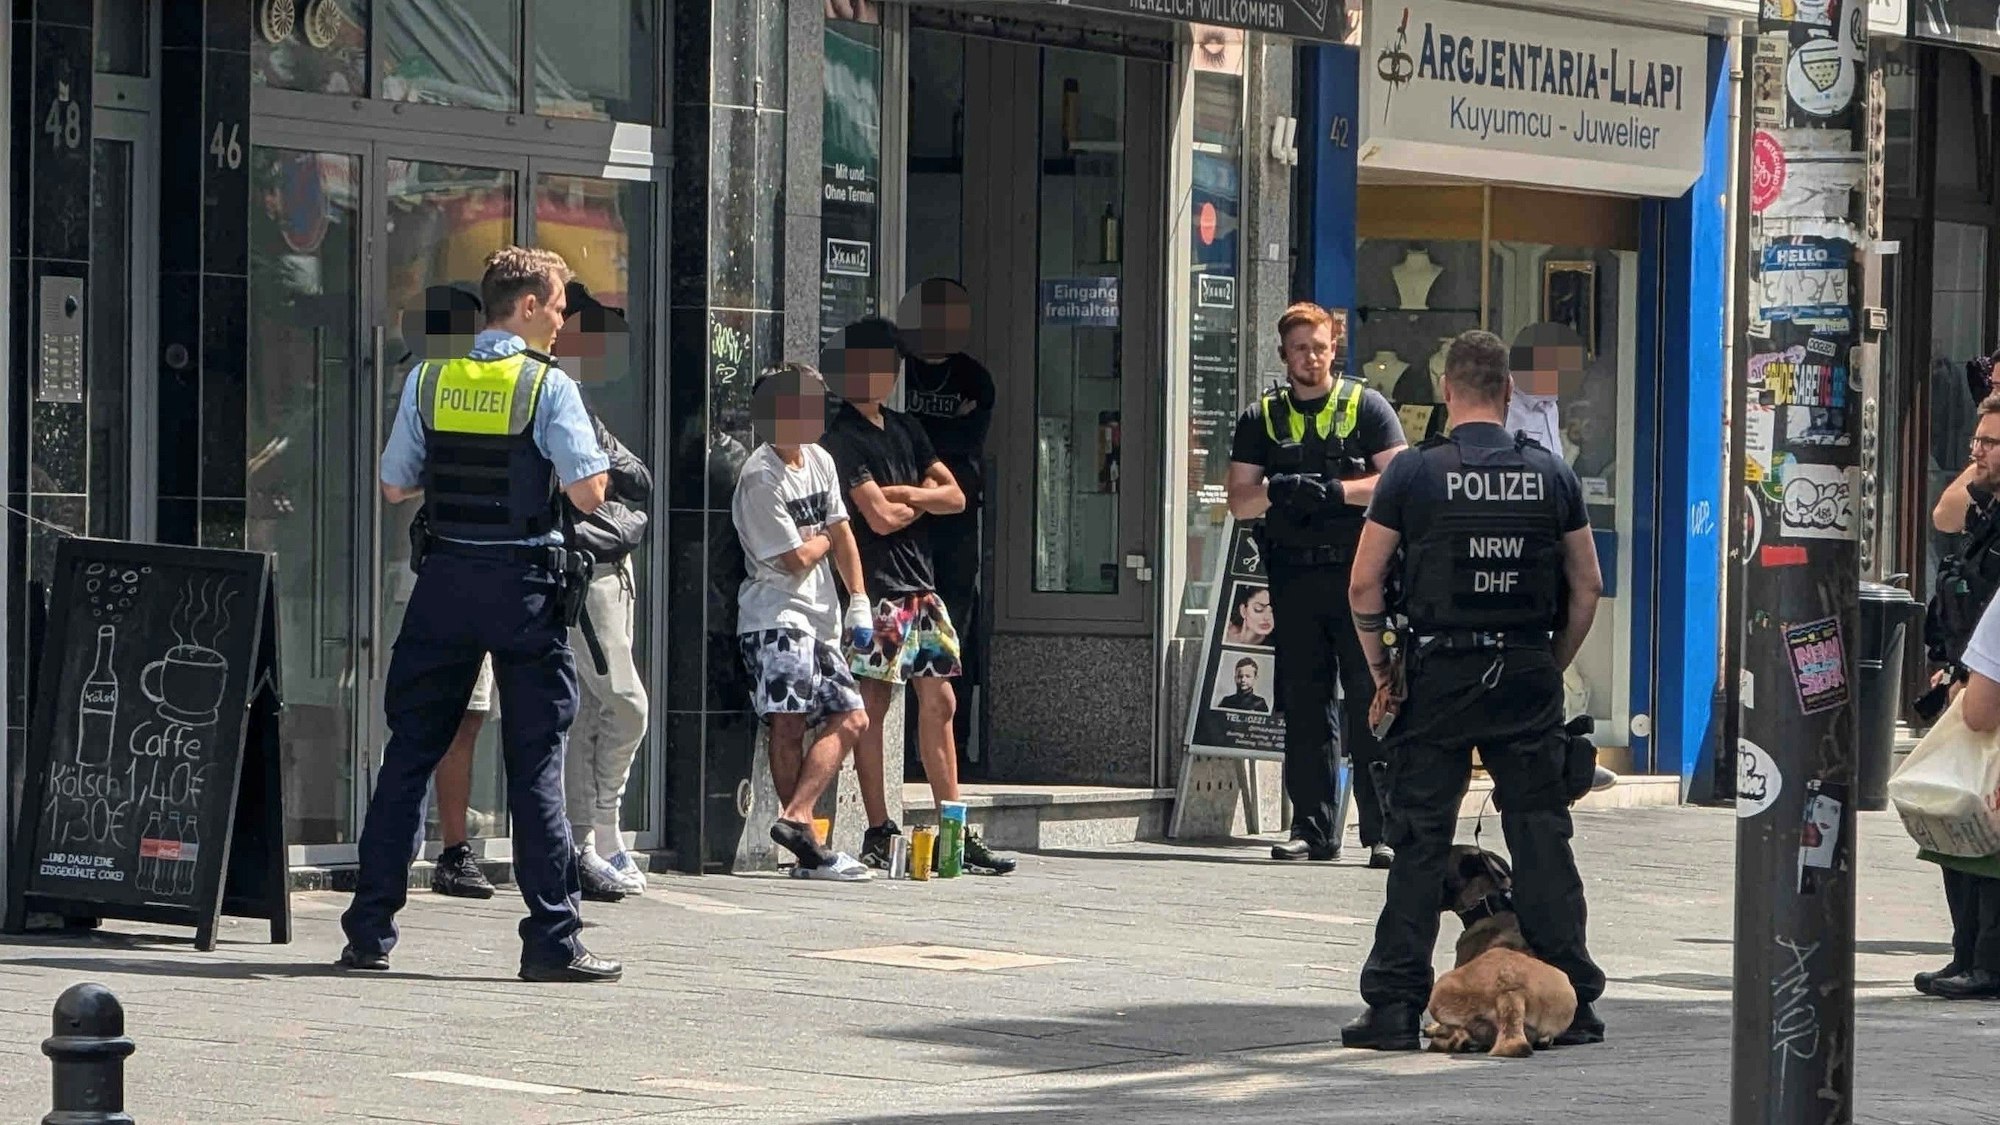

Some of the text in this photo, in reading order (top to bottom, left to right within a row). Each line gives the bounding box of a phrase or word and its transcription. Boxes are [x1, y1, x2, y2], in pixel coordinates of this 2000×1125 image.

[1199, 0, 1284, 29] WILLKOMMEN
[1417, 22, 1683, 111] ARGJENTARIA-LLAPI
[45, 99, 81, 149] 48
[1329, 115, 1349, 149] 42
[1450, 95, 1552, 140] Kuyumcu
[1573, 109, 1660, 150] Juwelier
[209, 121, 242, 170] 46
[835, 163, 865, 182] Mit und
[825, 183, 875, 204] Ohne Termin
[1776, 248, 1828, 263] HELLO
[1054, 284, 1118, 302] Eingang
[1045, 302, 1121, 318] freihalten
[440, 388, 507, 414] POLIZEI
[1446, 472, 1544, 501] POLIZEI
[1469, 537, 1525, 559] NRW
[1474, 571, 1519, 593] DHF
[129, 721, 201, 760] Caffe
[50, 761, 122, 798] Kölsch
[46, 797, 129, 850] 1,30€
